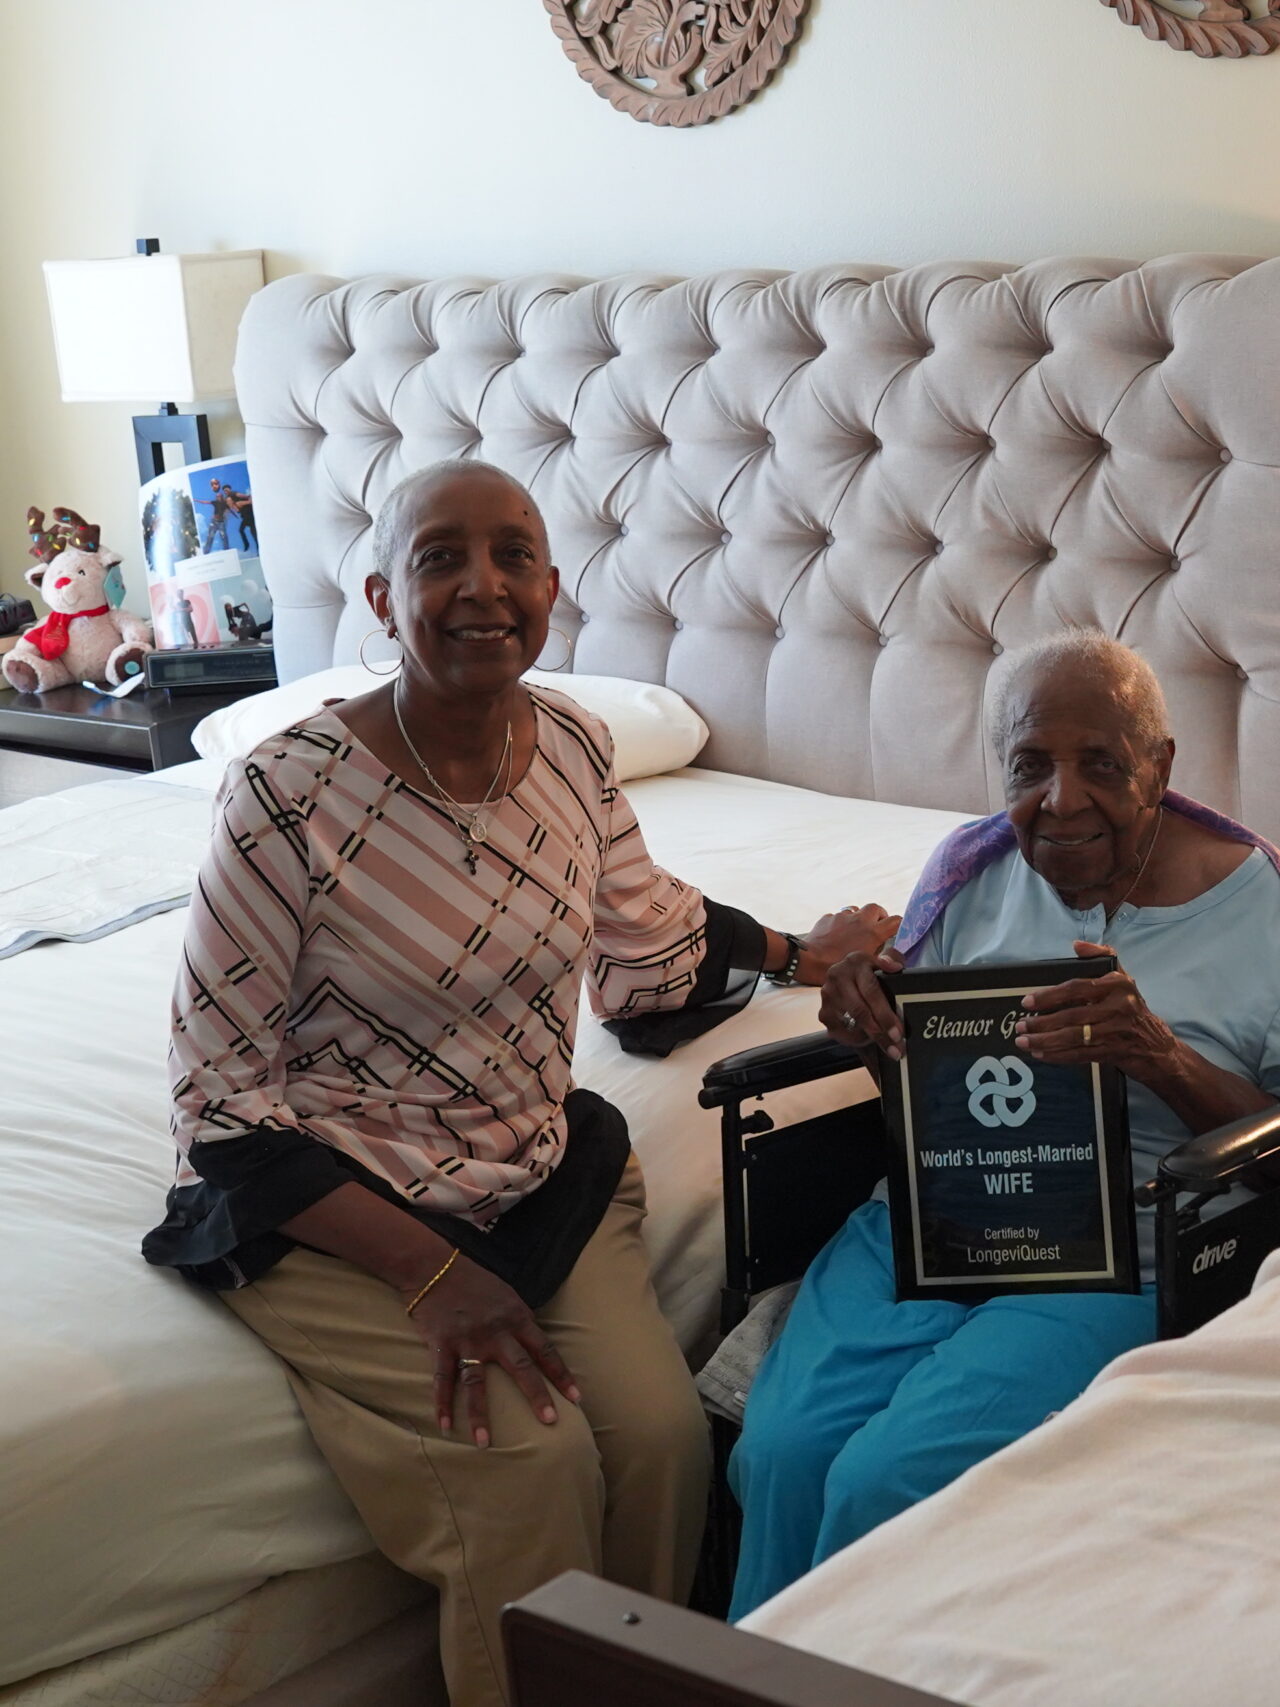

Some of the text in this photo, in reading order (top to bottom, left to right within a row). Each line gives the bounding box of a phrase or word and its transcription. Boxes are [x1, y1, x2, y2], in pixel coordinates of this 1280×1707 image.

[923, 1016, 993, 1039] Eleanor
[920, 1143, 1094, 1168] World's Longest-Married
[984, 1172, 1034, 1195] WIFE
[984, 1226, 1040, 1241] Certified by
[967, 1244, 1061, 1265] LongeviQuest
[1192, 1238, 1237, 1274] drive
